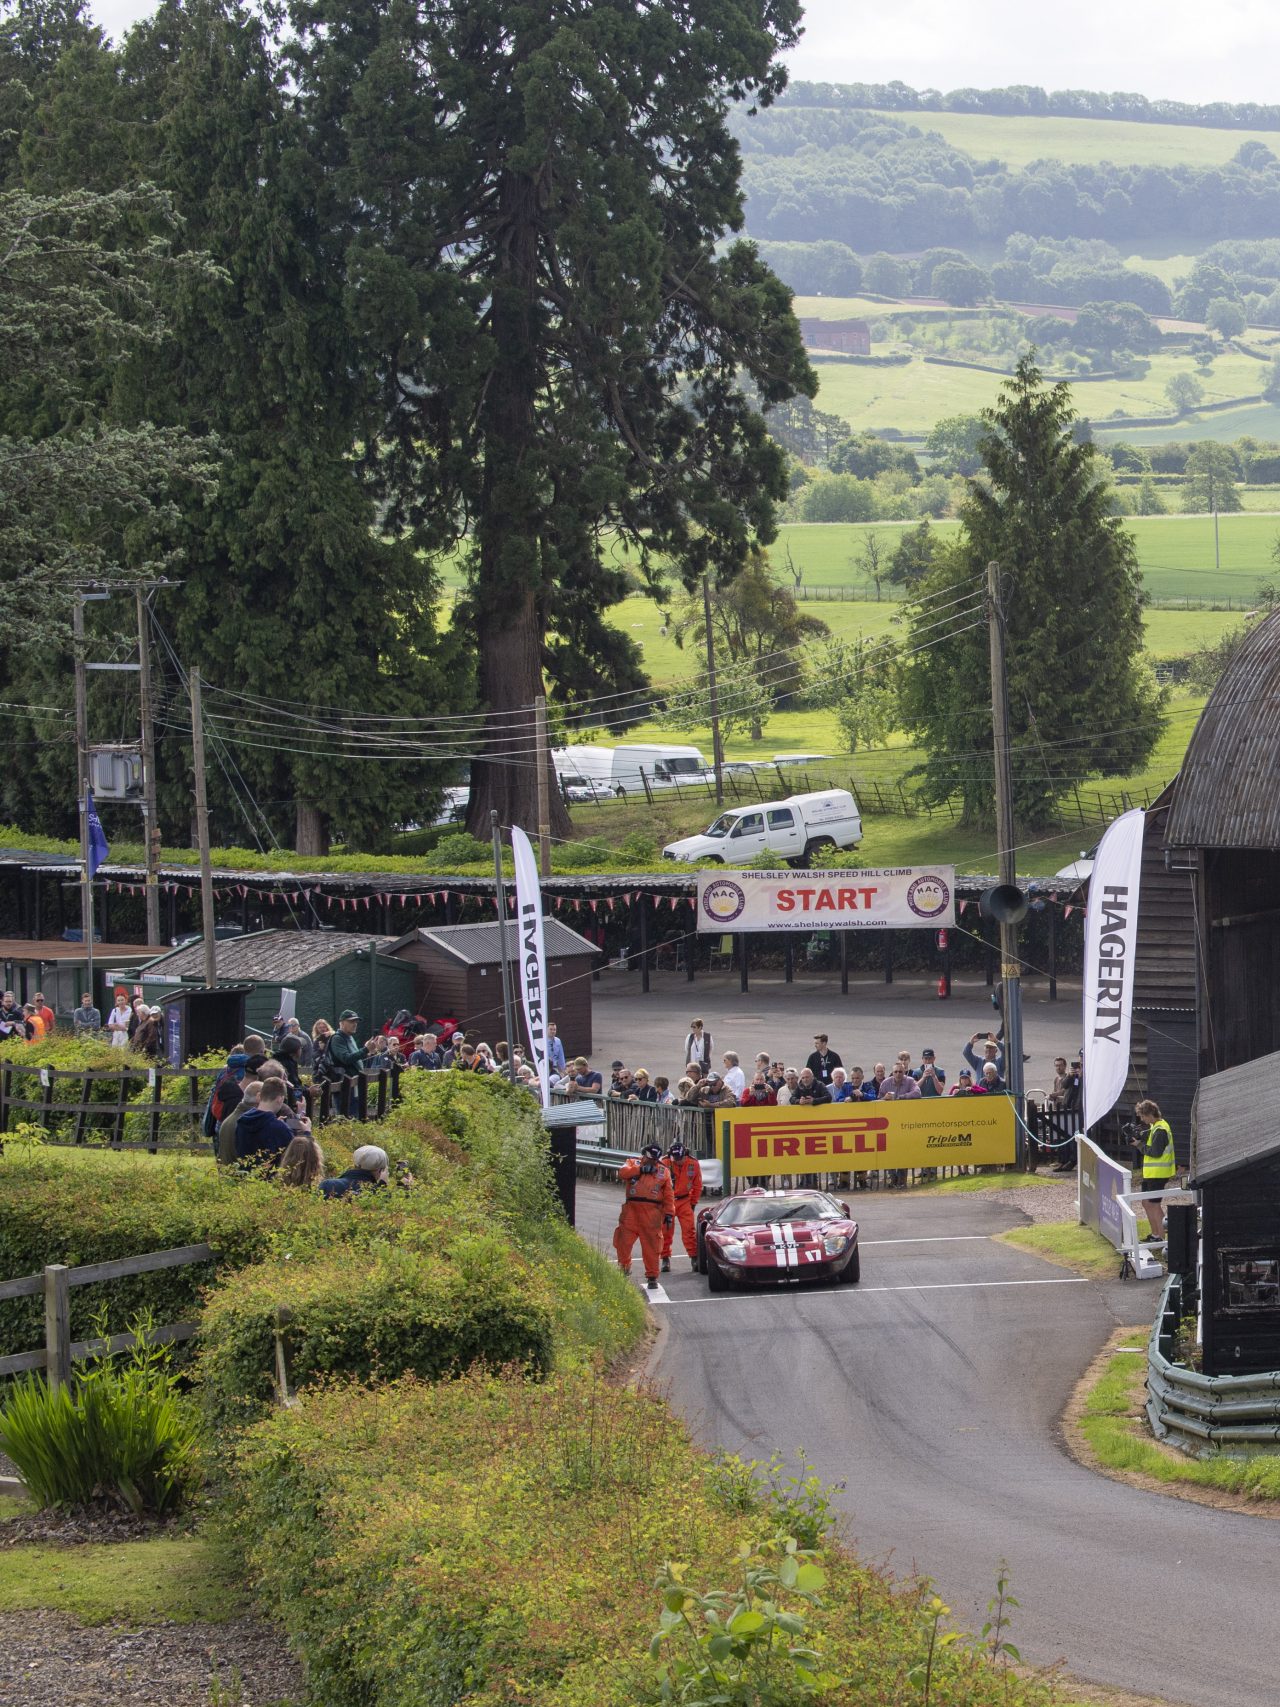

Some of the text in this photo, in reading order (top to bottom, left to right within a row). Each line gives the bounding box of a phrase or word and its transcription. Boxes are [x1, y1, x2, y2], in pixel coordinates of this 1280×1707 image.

[792, 871, 825, 879] WALSH
[861, 870, 881, 878] HILL
[883, 869, 912, 877] CLIMB
[776, 888, 878, 911] START
[768, 920, 887, 928] www.shelsleywalsh.com
[1094, 885, 1129, 1045] HAGERTY
[901, 1118, 997, 1130] triplemmotorsport.co.uk
[734, 1117, 889, 1159] PIRELLI
[805, 1250, 821, 1261] 17
